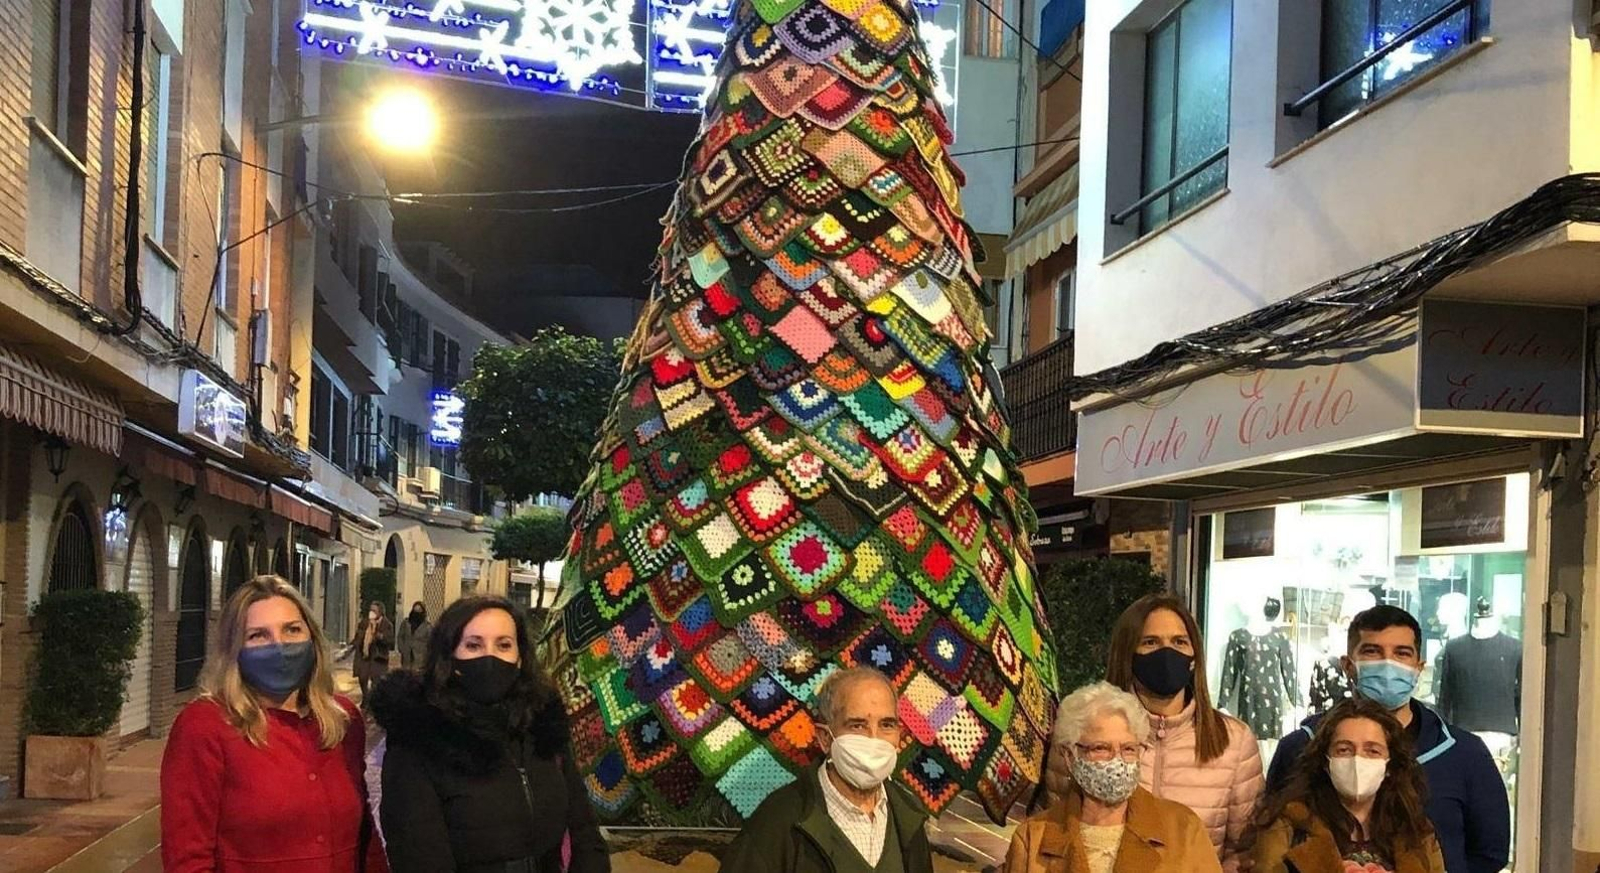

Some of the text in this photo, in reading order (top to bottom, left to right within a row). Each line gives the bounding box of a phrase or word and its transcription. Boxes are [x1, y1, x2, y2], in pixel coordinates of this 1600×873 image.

[1101, 357, 1358, 473] Arte y Estilo
[1446, 372, 1553, 412] Estilo
